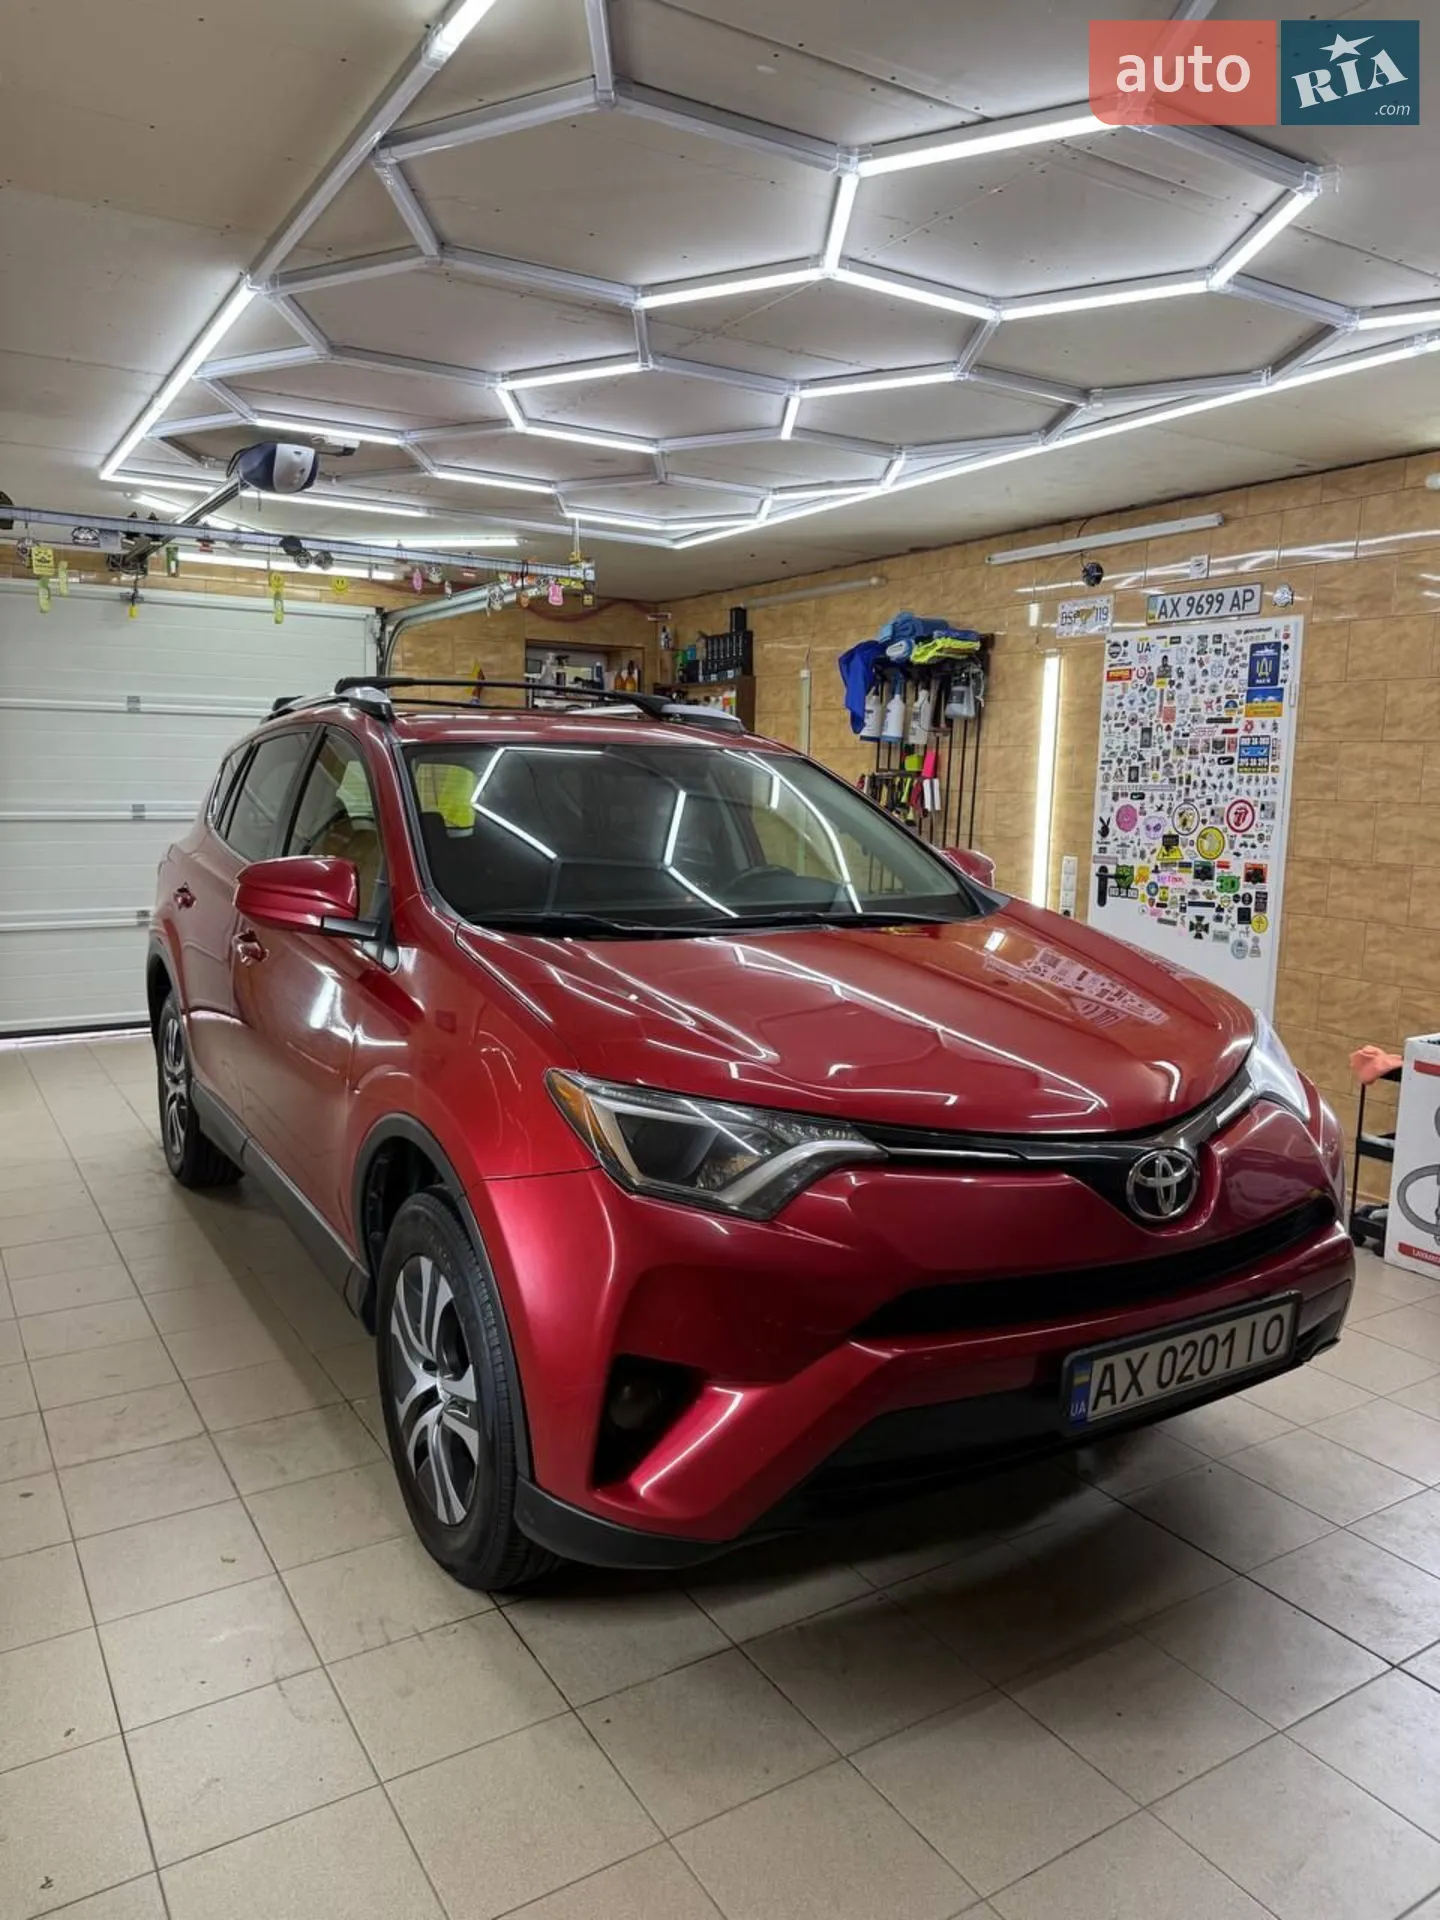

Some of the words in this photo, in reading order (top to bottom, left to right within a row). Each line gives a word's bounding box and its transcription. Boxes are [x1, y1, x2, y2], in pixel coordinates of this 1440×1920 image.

[1157, 598, 1182, 621] AX
[1186, 592, 1225, 617] 9699
[1229, 588, 1255, 612] AP
[1091, 1352, 1149, 1412] AX
[1156, 1326, 1237, 1390] 0201
[1070, 1401, 1087, 1417] UA
